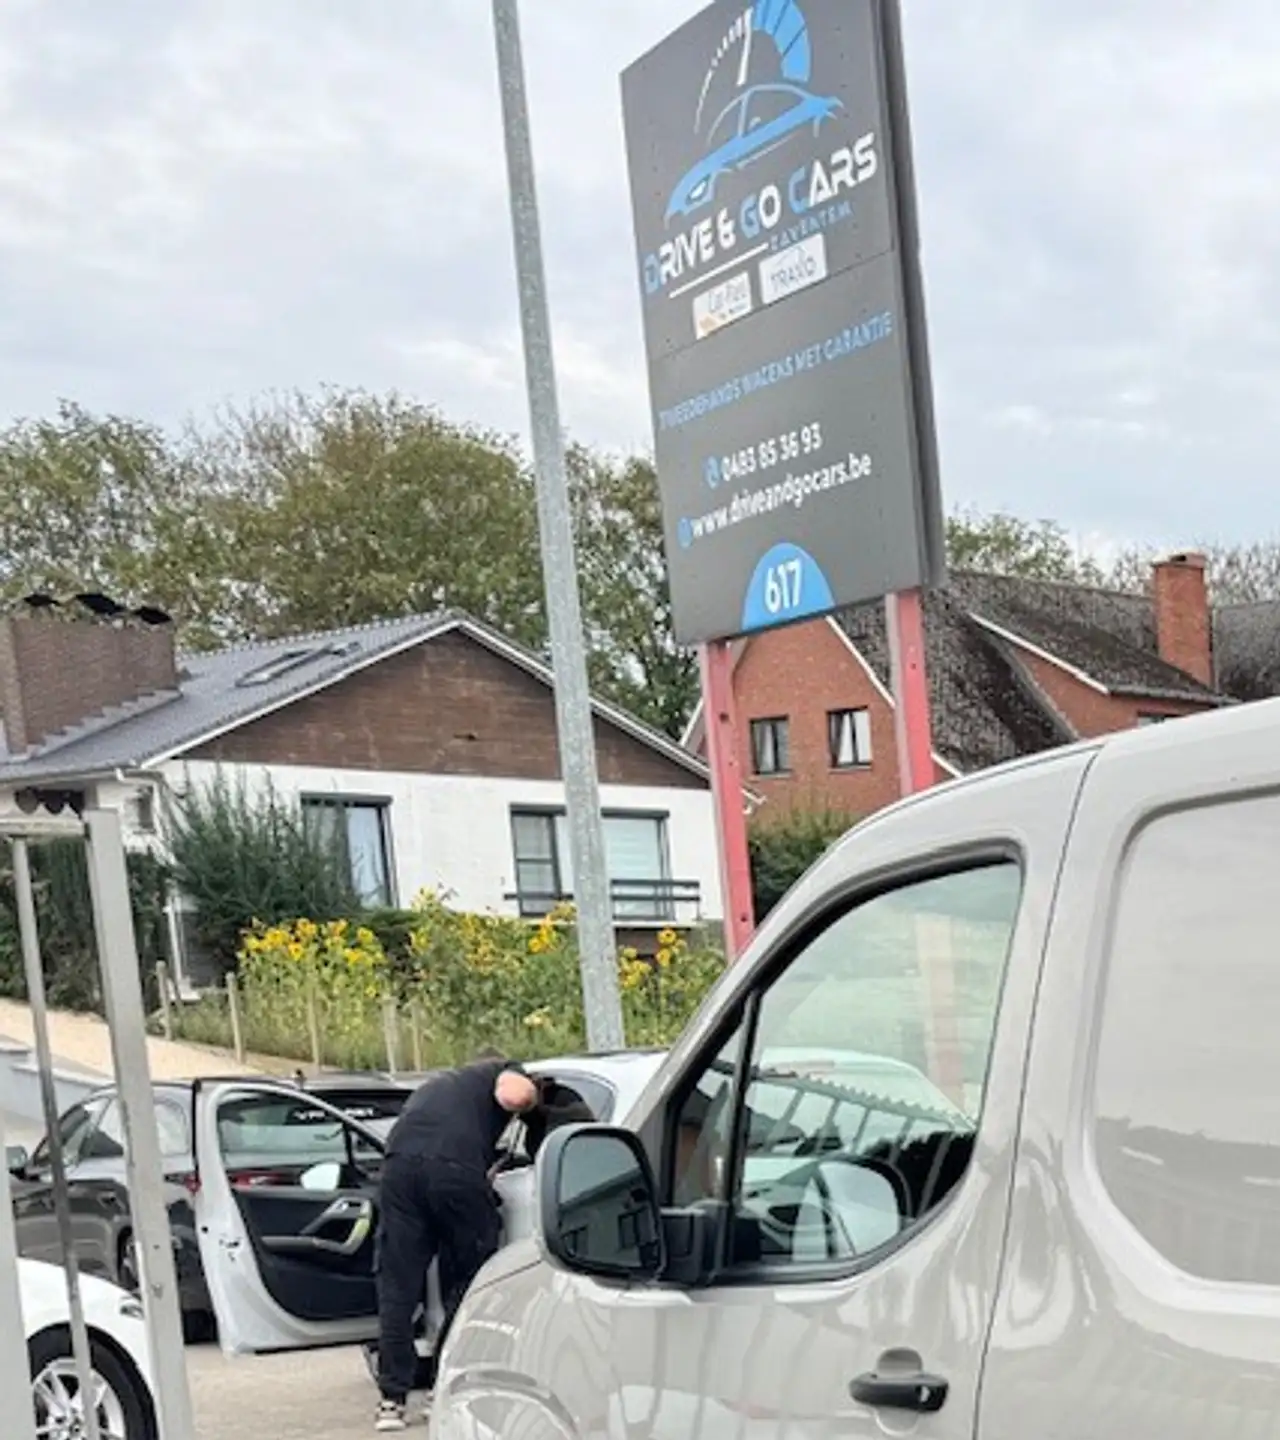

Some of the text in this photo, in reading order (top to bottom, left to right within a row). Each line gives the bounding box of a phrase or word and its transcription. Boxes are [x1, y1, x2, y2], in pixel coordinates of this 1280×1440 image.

[643, 132, 878, 294] DRIVE & GO CARS
[795, 344, 823, 371] MET
[758, 438, 778, 469] 85
[780, 431, 800, 460] 36
[801, 422, 823, 454] 93
[691, 452, 872, 537] www.driveandgocars.be
[764, 557, 802, 614] 617
